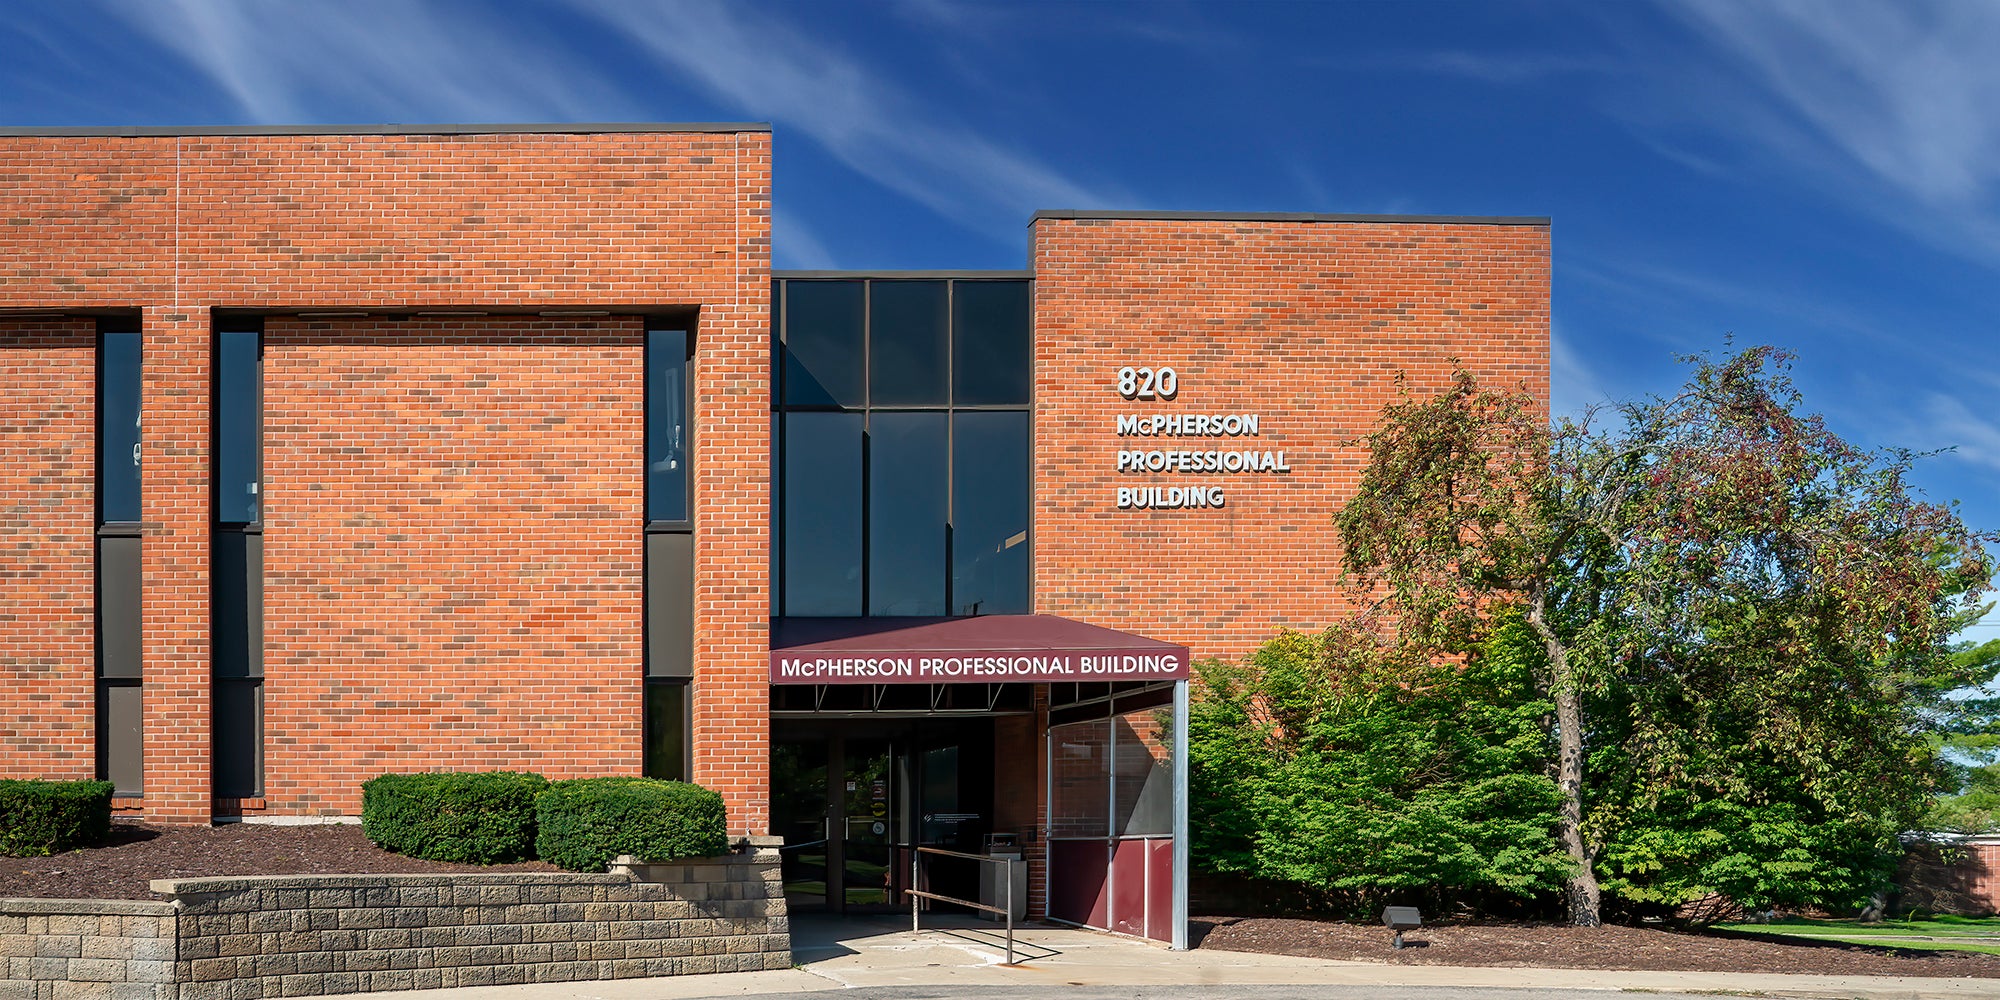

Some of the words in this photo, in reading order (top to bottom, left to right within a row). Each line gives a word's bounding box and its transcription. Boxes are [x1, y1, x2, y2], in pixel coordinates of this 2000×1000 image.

[1117, 366, 1178, 399] 820
[1117, 414, 1259, 436] McPHERSON
[1117, 451, 1291, 473] PROFESSIONAL
[1117, 487, 1225, 509] BUILDING
[781, 658, 912, 677] McPHERSON
[919, 656, 1075, 676] PROFESSIONAL
[1080, 654, 1179, 674] BUILDING
